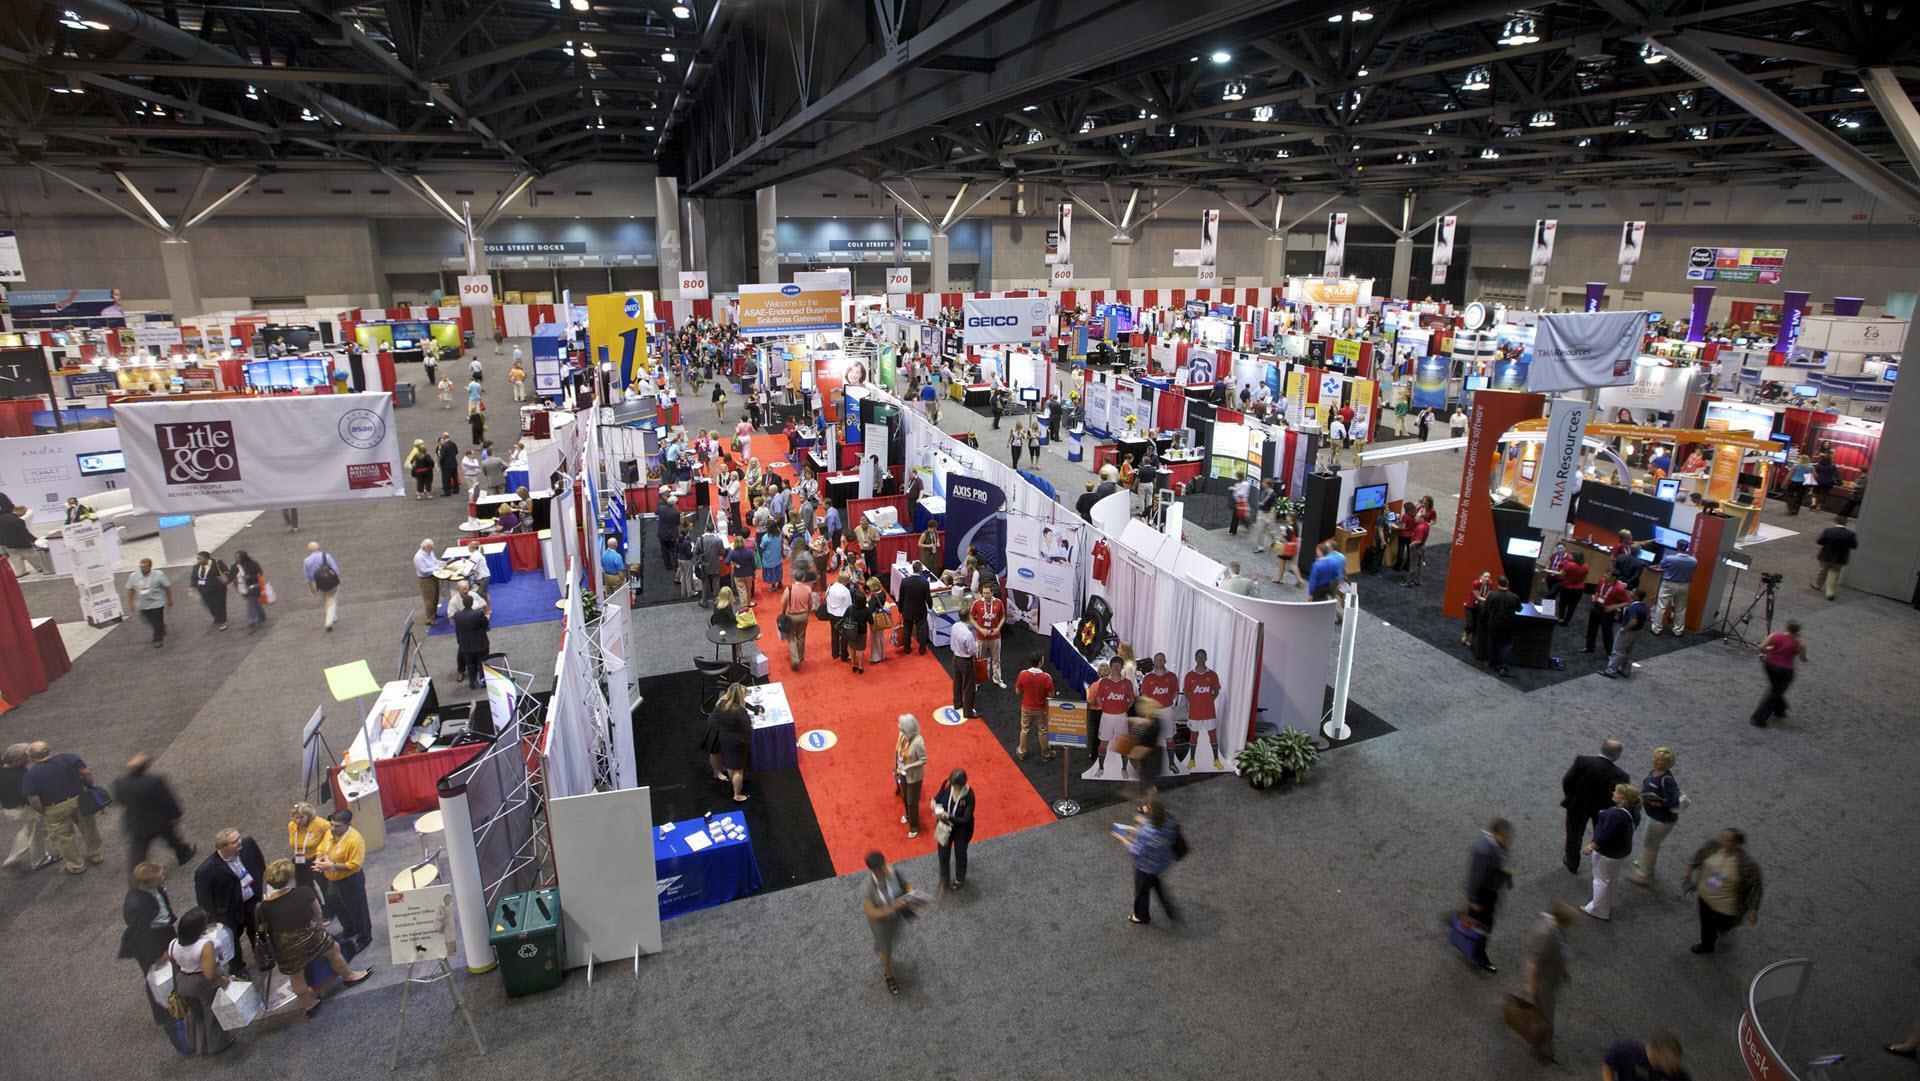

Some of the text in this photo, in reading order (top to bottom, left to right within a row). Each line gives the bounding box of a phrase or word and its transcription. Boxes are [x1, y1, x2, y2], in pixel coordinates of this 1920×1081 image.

[661, 229, 680, 253] 4
[760, 228, 776, 252] 5
[890, 275, 908, 284] 700
[1054, 270, 1071, 278] 600
[1200, 271, 1214, 279] 500
[464, 284, 488, 294] 900
[683, 280, 705, 289] 800
[744, 307, 804, 316] ASAE-Endorsed
[757, 314, 828, 324] Solutions Gateway!
[968, 316, 1018, 328] GEICO
[618, 328, 638, 392] 1
[161, 424, 230, 450] Litle
[170, 448, 234, 481] &Co
[1455, 405, 1484, 546] The leader in member-centric software
[952, 485, 972, 498] AXIS
[972, 488, 988, 501] PRO
[1107, 692, 1124, 700] AON
[1153, 686, 1168, 695] AON
[1745, 1026, 1770, 1079] Desk
